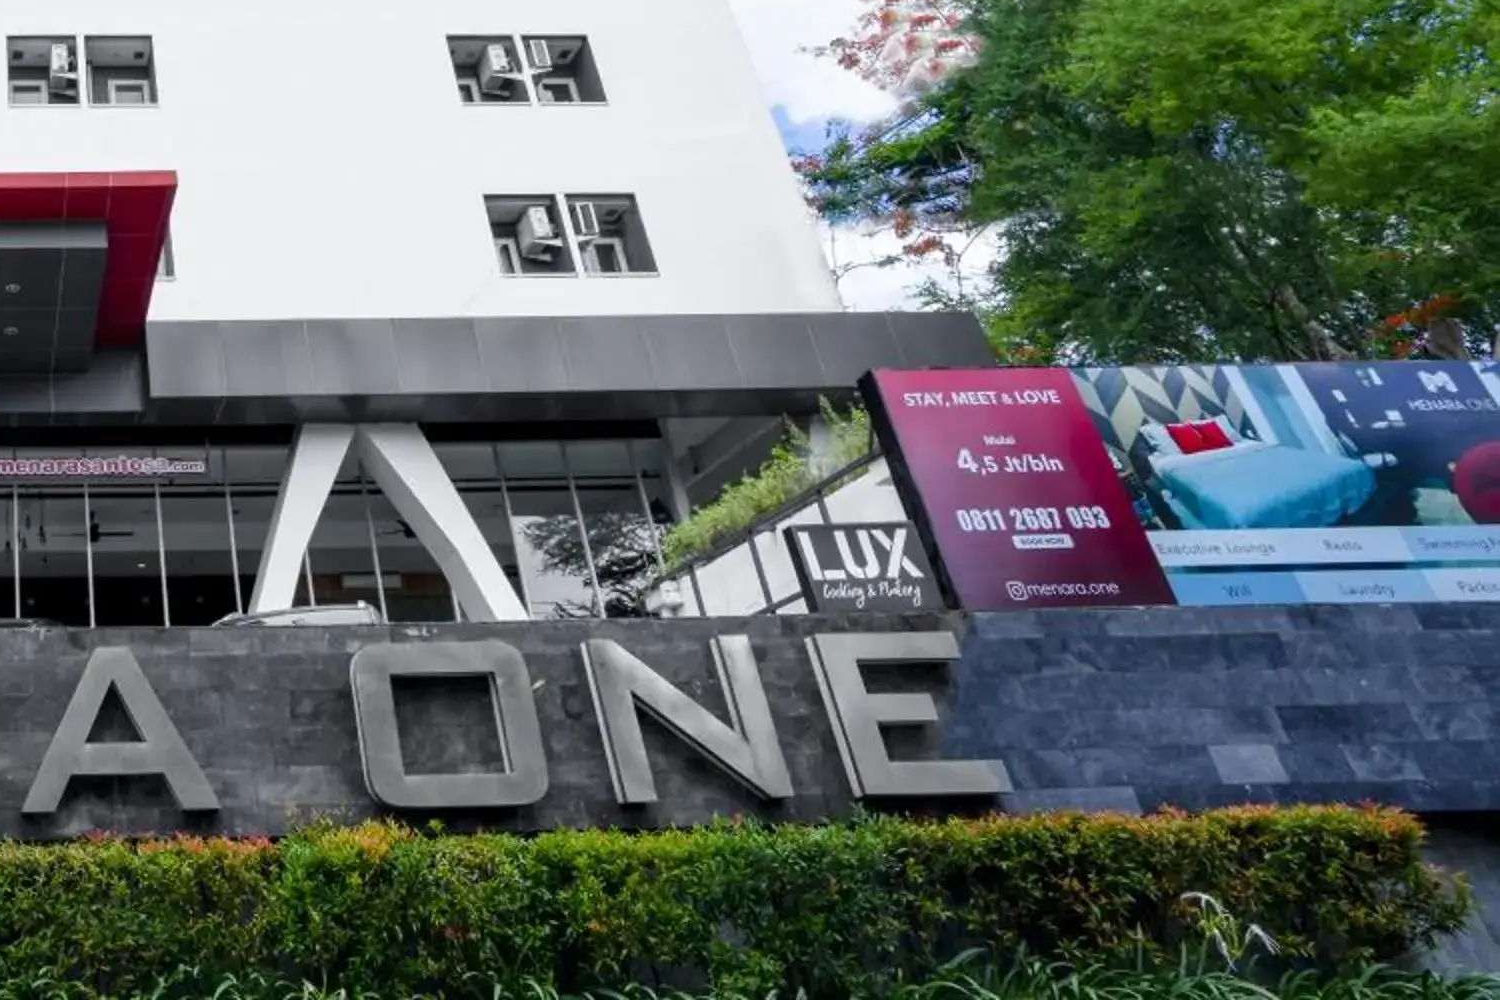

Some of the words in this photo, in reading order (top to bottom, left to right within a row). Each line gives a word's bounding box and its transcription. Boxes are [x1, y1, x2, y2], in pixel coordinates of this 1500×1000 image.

[903, 392, 950, 408] STAY,
[952, 391, 998, 406] MEET
[1001, 393, 1013, 405] &
[1015, 389, 1061, 404] LOVE
[957, 448, 999, 476] 4,5
[1004, 453, 1065, 473] Jt/bln
[956, 509, 1007, 531] 0811
[1009, 507, 1062, 530] 2687
[1065, 505, 1111, 529] 093
[797, 528, 924, 580] LUX
[1156, 543, 1222, 555] Executive
[1225, 543, 1277, 556] Lounge
[867, 583, 876, 597] &
[1027, 581, 1120, 597] menara.one
[350, 631, 1014, 806] ONE
